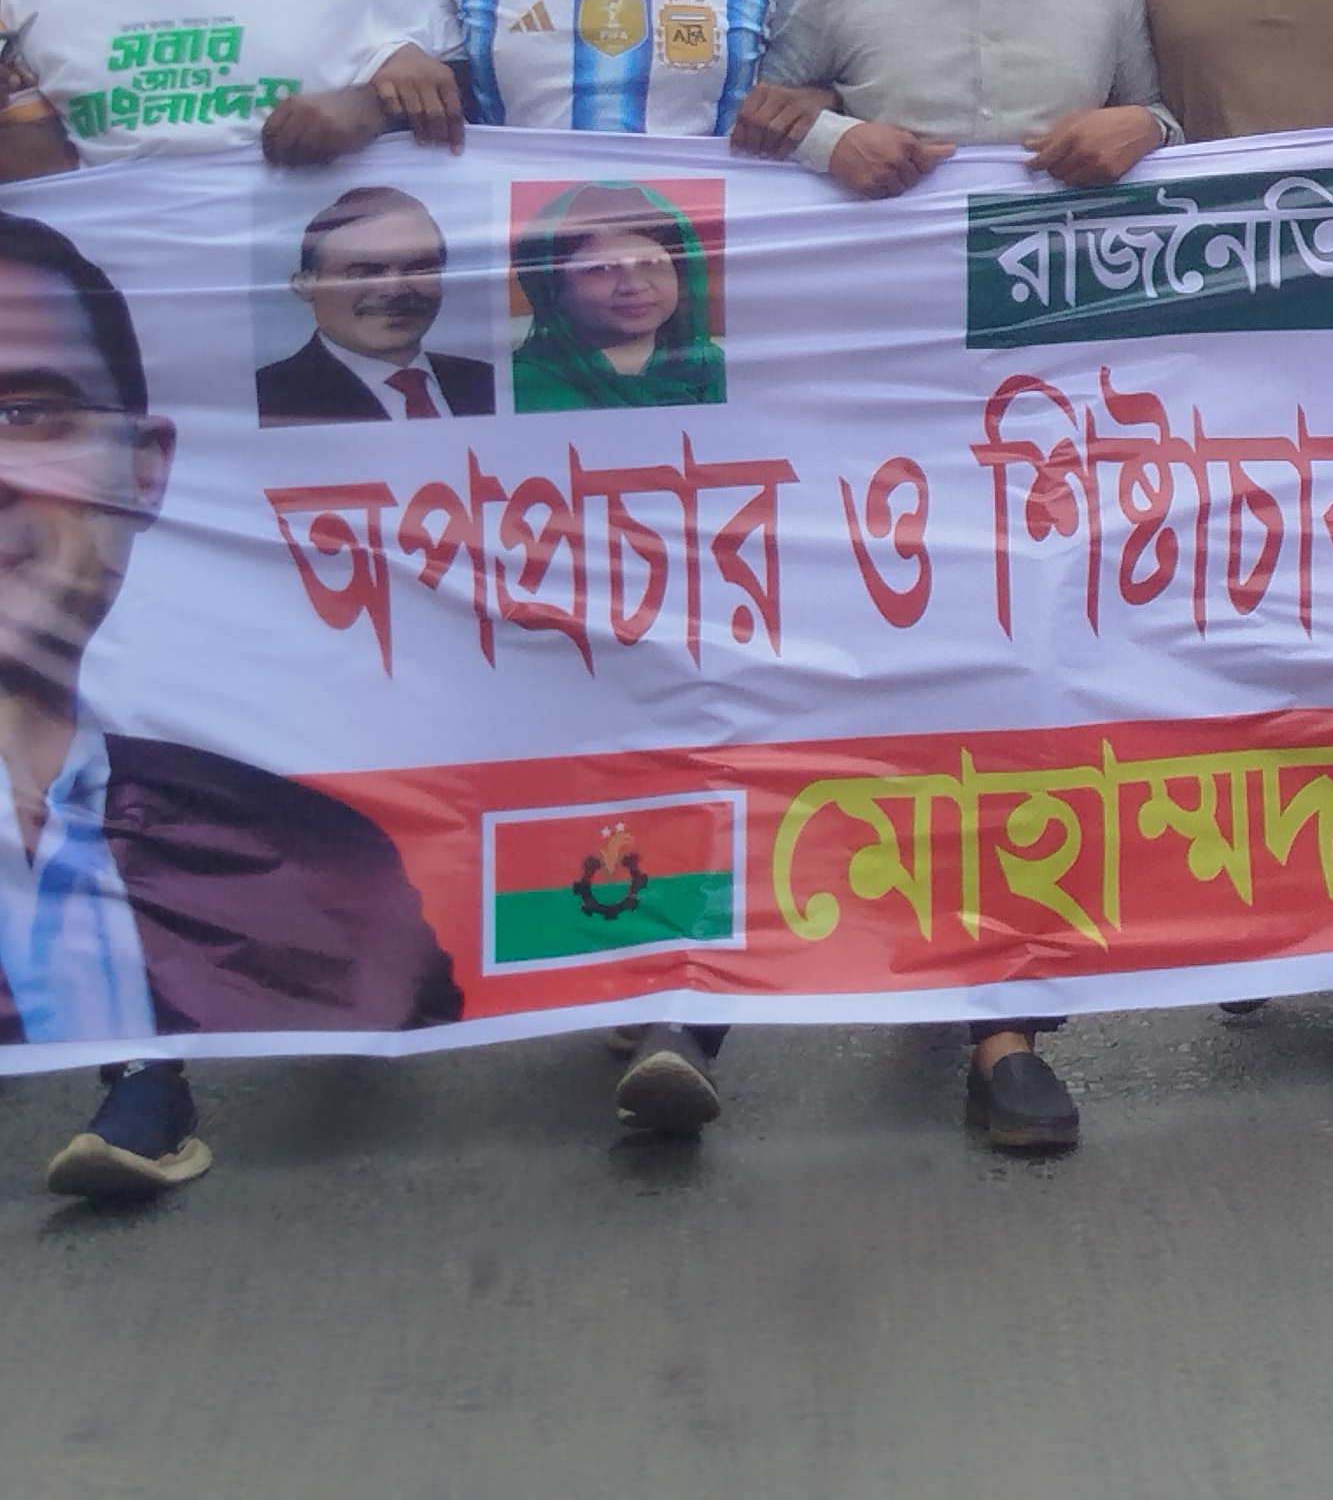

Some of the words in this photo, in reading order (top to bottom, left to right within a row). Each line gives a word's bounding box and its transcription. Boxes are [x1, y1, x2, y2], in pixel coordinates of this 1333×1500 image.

[107, 25, 245, 75] সবার
[132, 67, 211, 92] আগে
[264, 431, 799, 680] অপপ্রচার
[839, 456, 933, 630] ও
